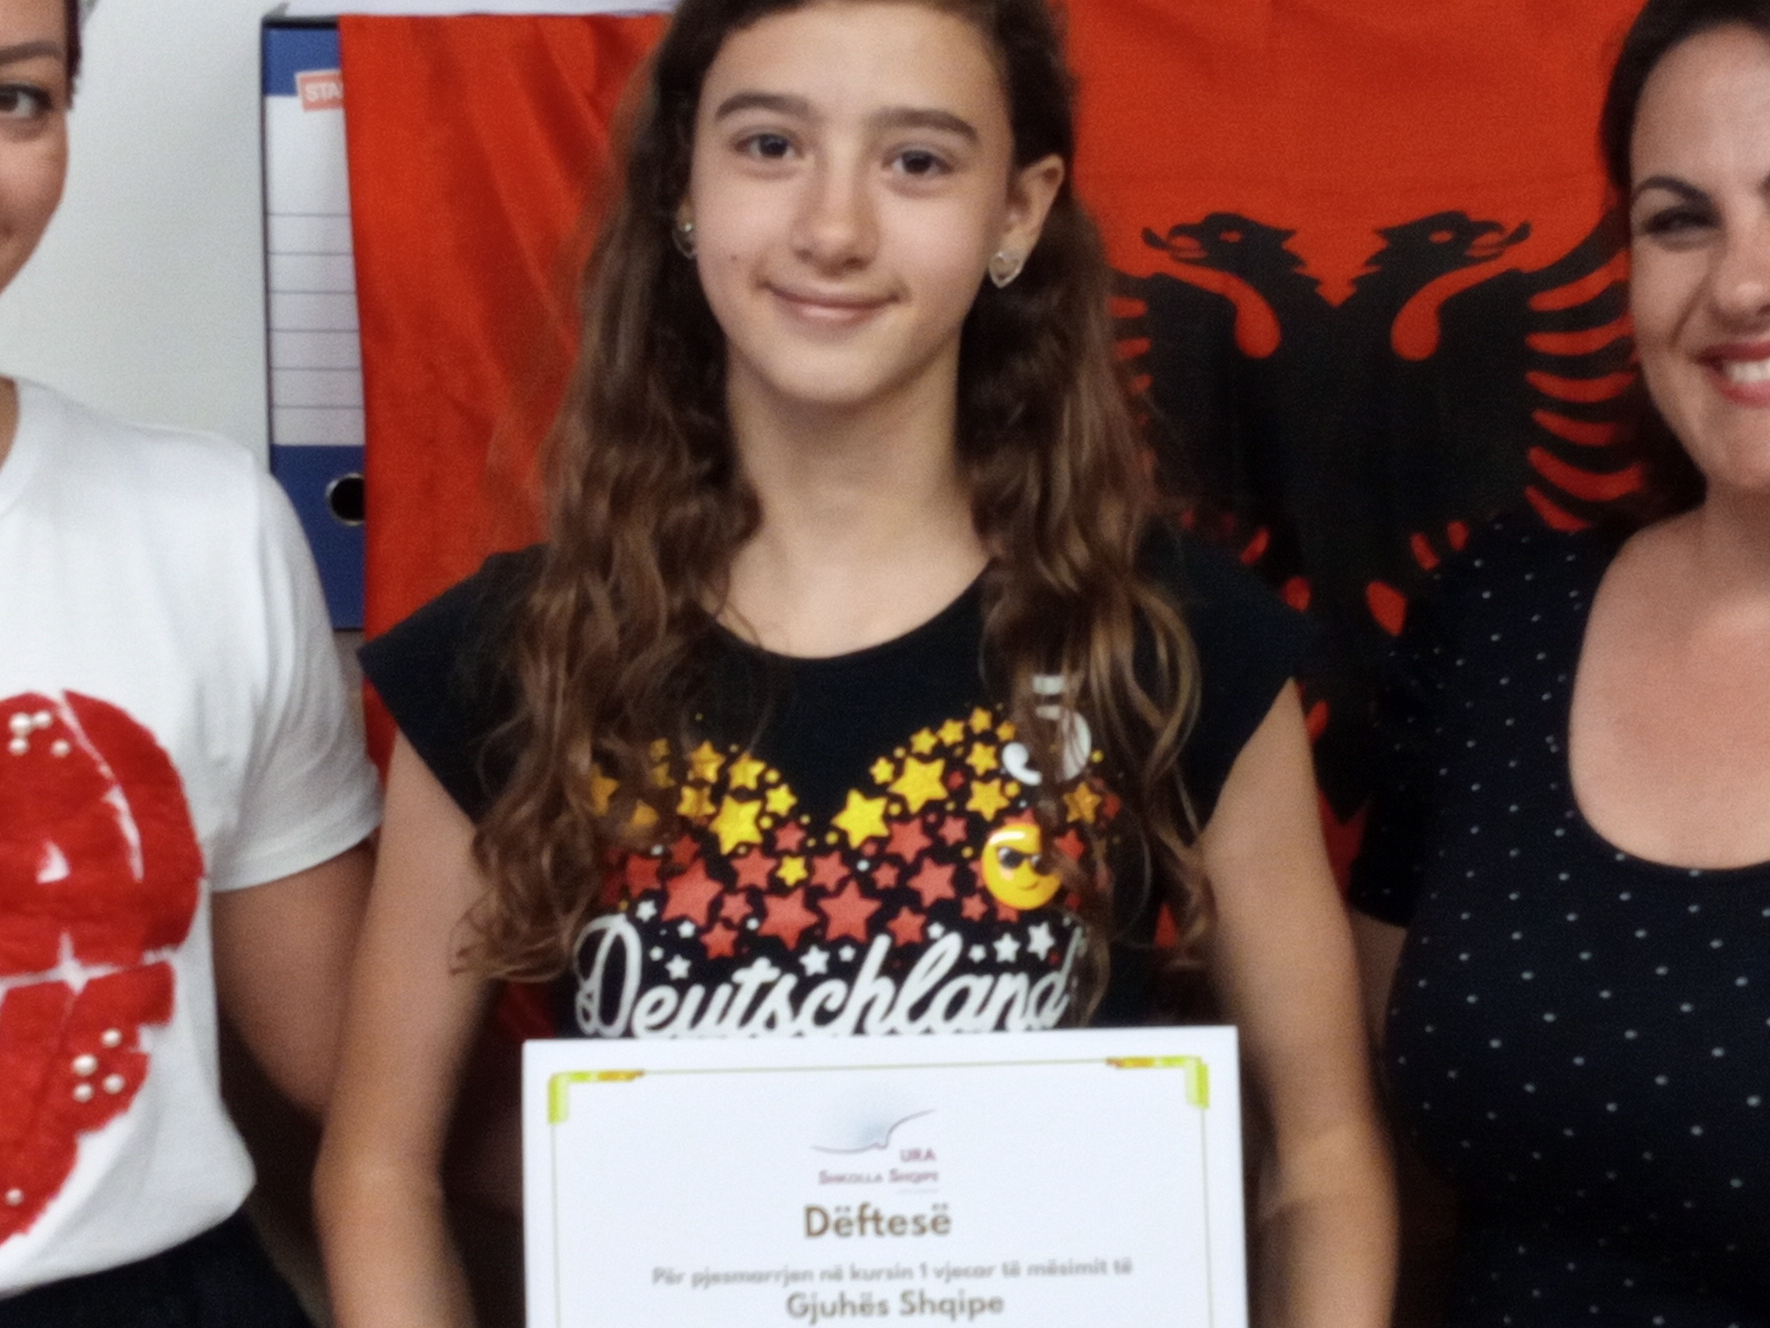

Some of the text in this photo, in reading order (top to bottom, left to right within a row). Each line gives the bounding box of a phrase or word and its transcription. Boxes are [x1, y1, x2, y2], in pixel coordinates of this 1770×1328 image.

[573, 914, 1088, 1039] Deutschland
[804, 1202, 952, 1238] Dëftesë
[786, 1288, 1005, 1326] Gjuhës Shqipe
